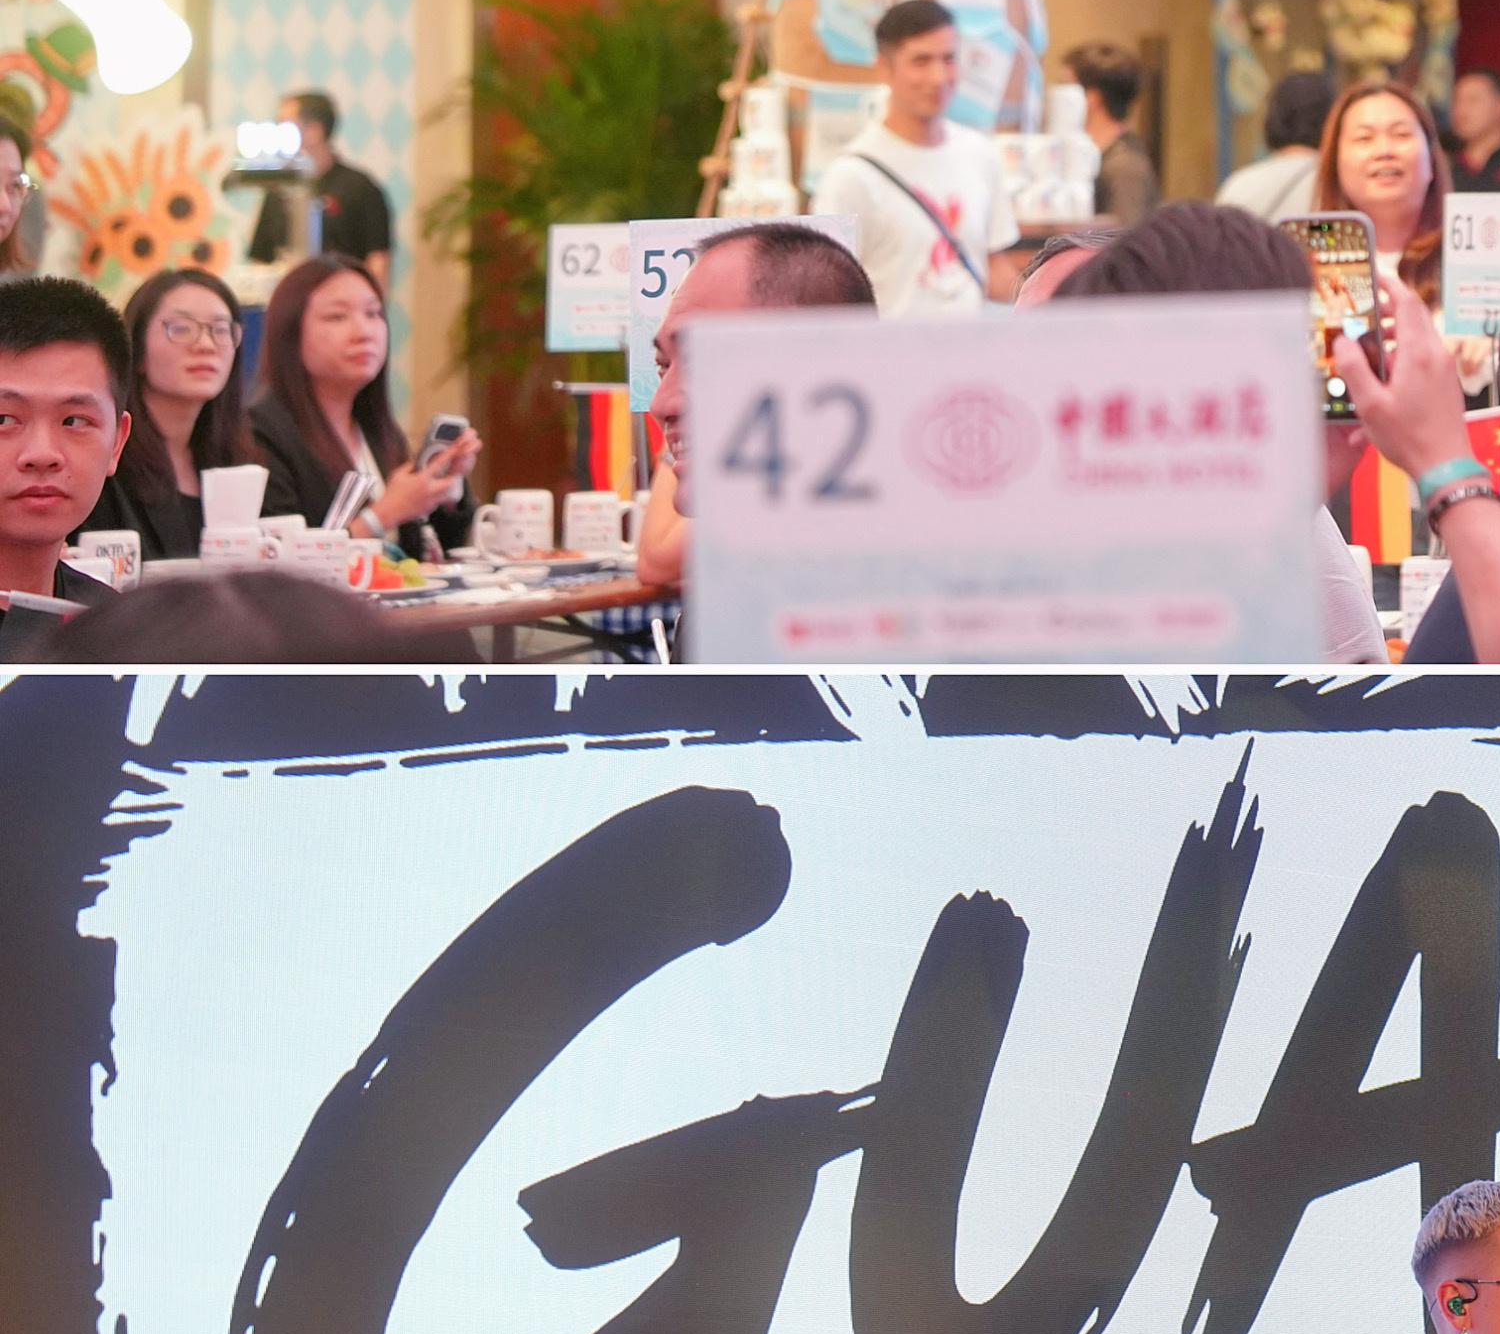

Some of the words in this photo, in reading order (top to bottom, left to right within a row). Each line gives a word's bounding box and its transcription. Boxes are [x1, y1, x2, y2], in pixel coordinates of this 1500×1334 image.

[1452, 215, 1475, 250] 61
[561, 243, 602, 277] 62
[719, 381, 881, 504] 42
